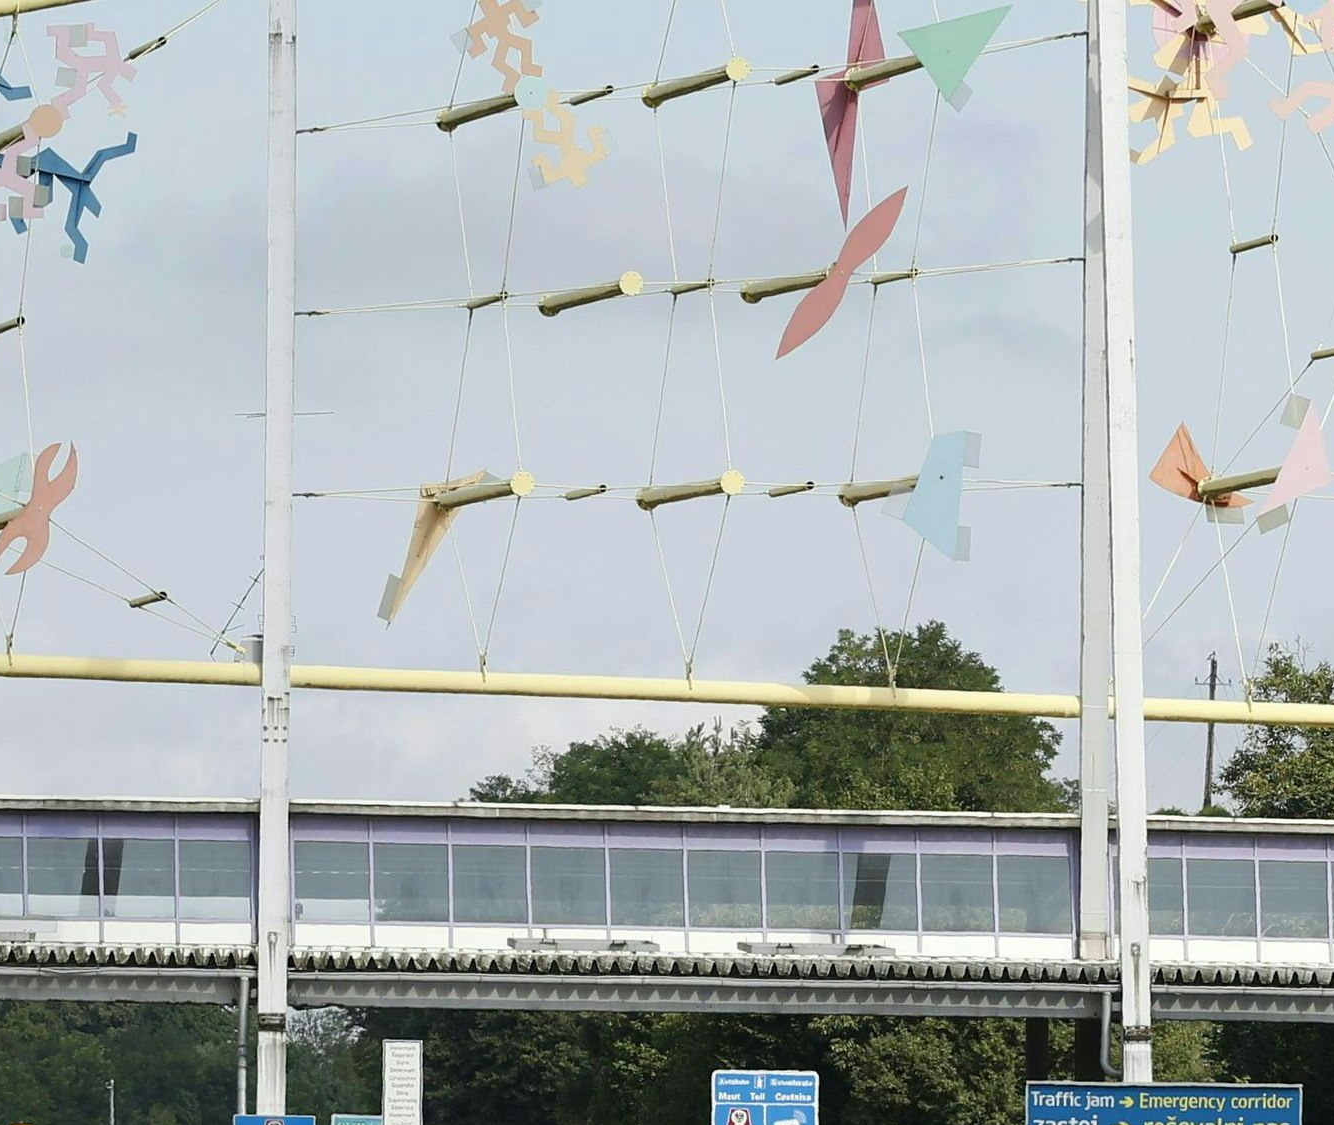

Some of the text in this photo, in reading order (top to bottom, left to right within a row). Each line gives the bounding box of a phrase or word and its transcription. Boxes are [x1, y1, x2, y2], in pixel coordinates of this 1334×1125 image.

[718, 1092, 741, 1101] Maut
[750, 1092, 766, 1101] Toll
[1031, 1091, 1293, 1112] Traffic jam Emergency corridor
